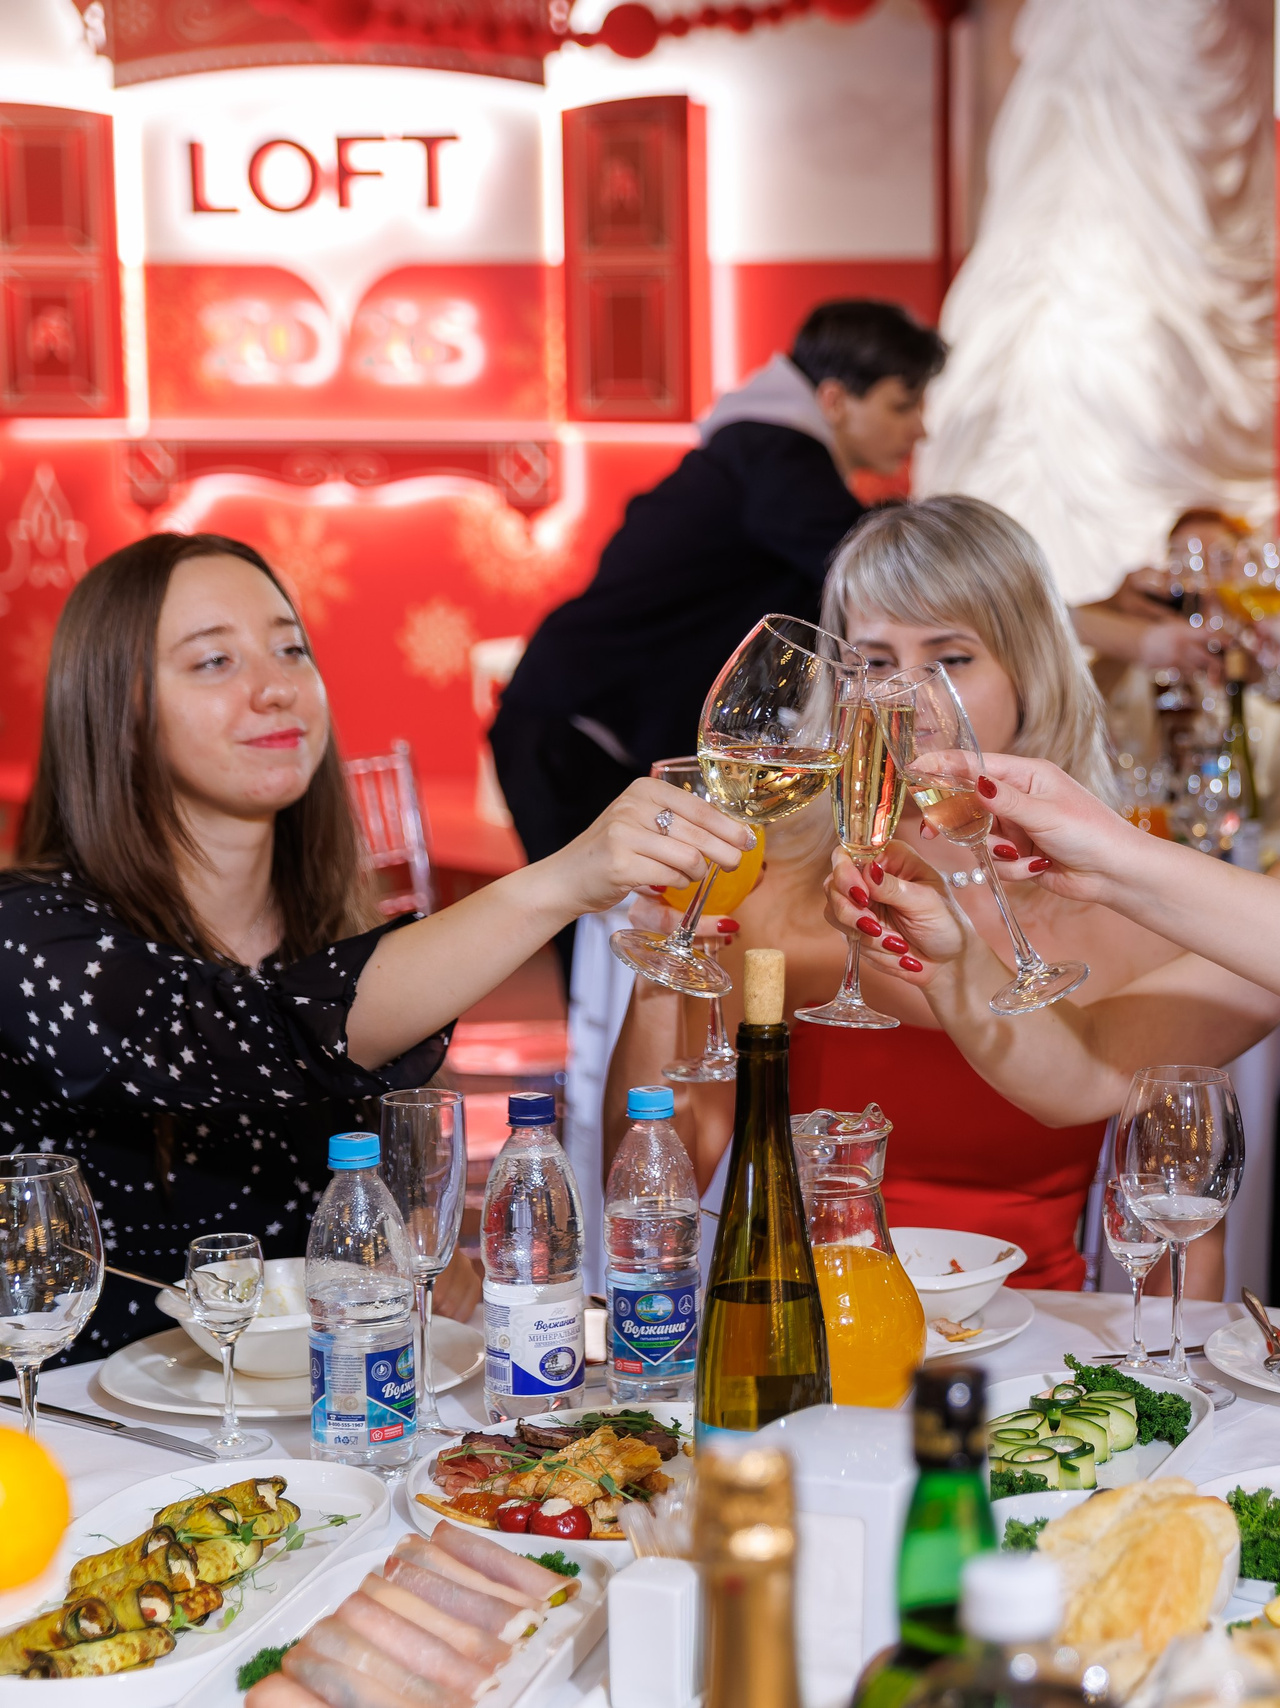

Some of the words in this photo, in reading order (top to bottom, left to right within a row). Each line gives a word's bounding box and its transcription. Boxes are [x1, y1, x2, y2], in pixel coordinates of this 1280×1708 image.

[188, 134, 460, 213] LOFT
[534, 1317, 577, 1332] Волжанка
[622, 1319, 687, 1338] Волжанка
